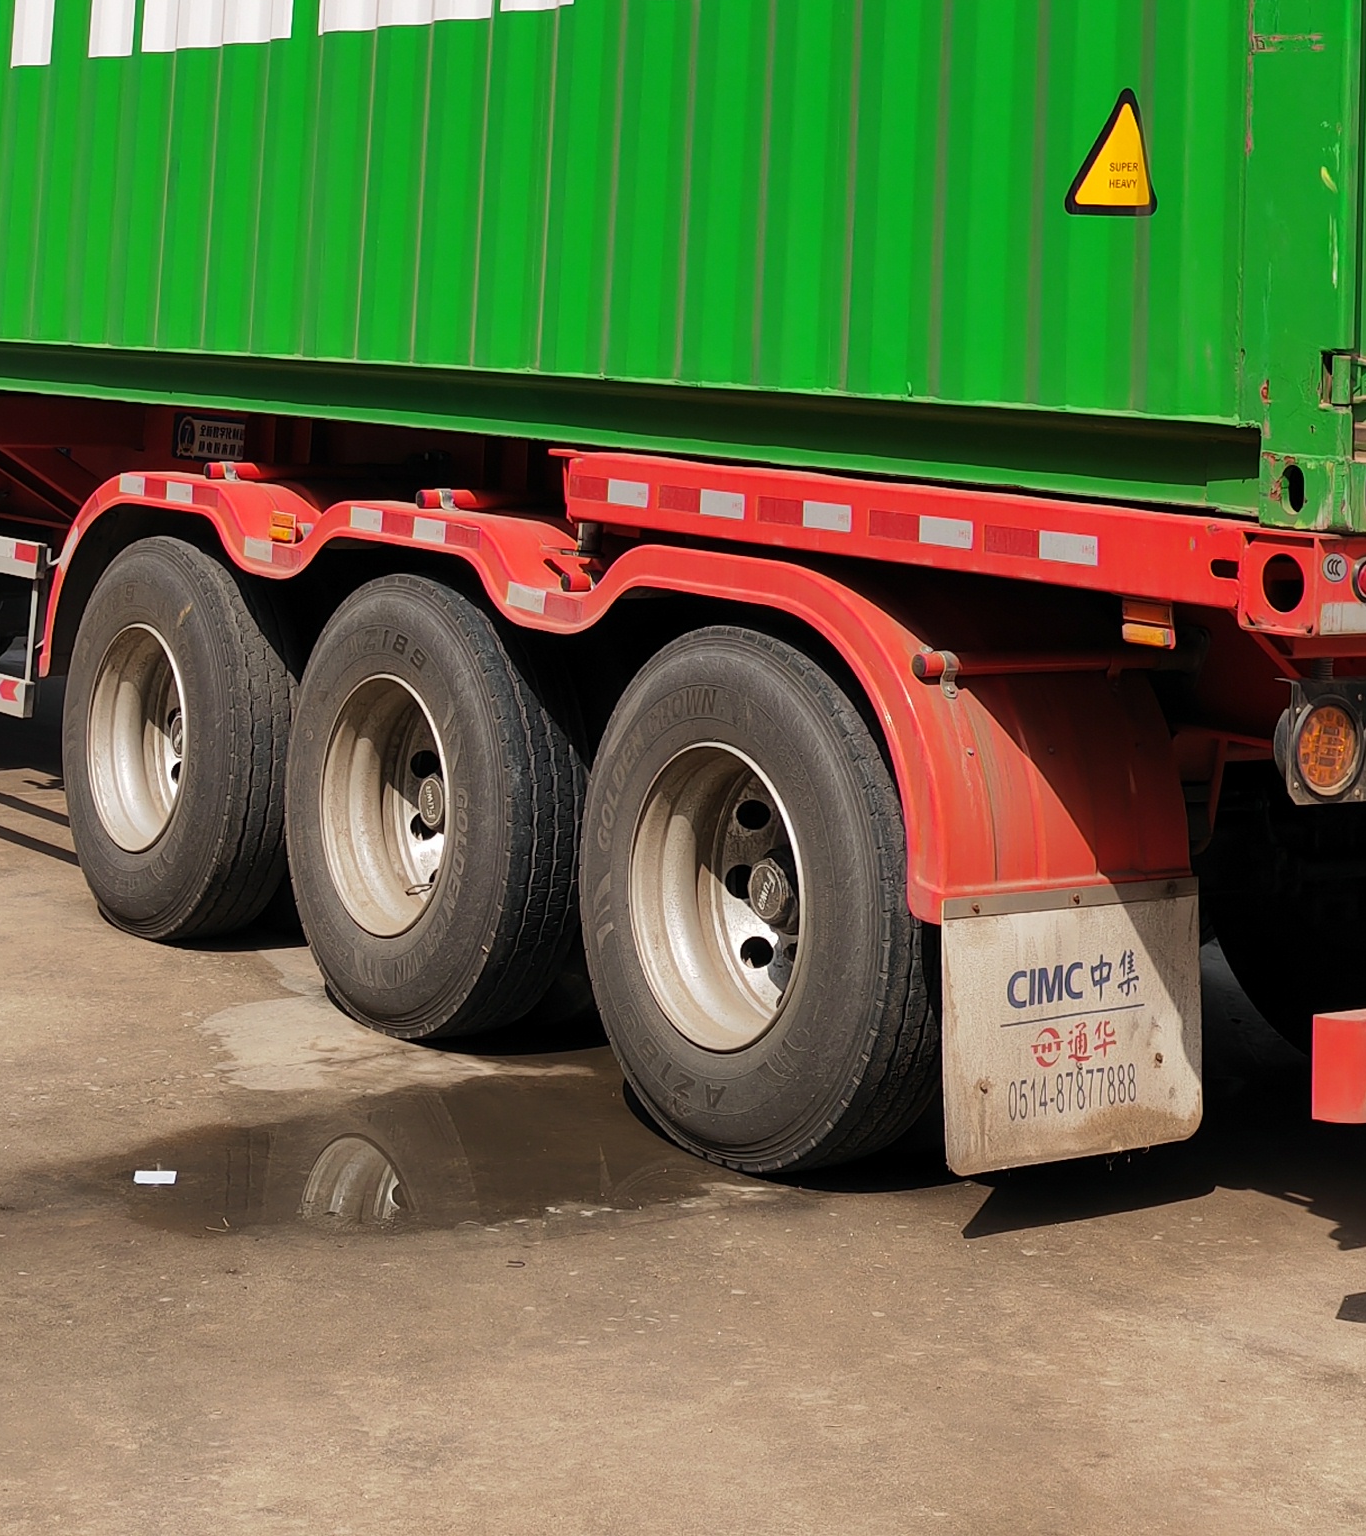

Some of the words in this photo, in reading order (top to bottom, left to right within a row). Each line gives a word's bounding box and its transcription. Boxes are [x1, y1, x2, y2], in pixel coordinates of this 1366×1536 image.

[1109, 162, 1139, 172] SUPER
[1109, 179, 1138, 189] HEAVY
[1007, 961, 1083, 1009] CIMC
[1090, 949, 1140, 1002] 中集
[1067, 1020, 1118, 1062] 通华
[1007, 1063, 1136, 1122] 0514-87877888
